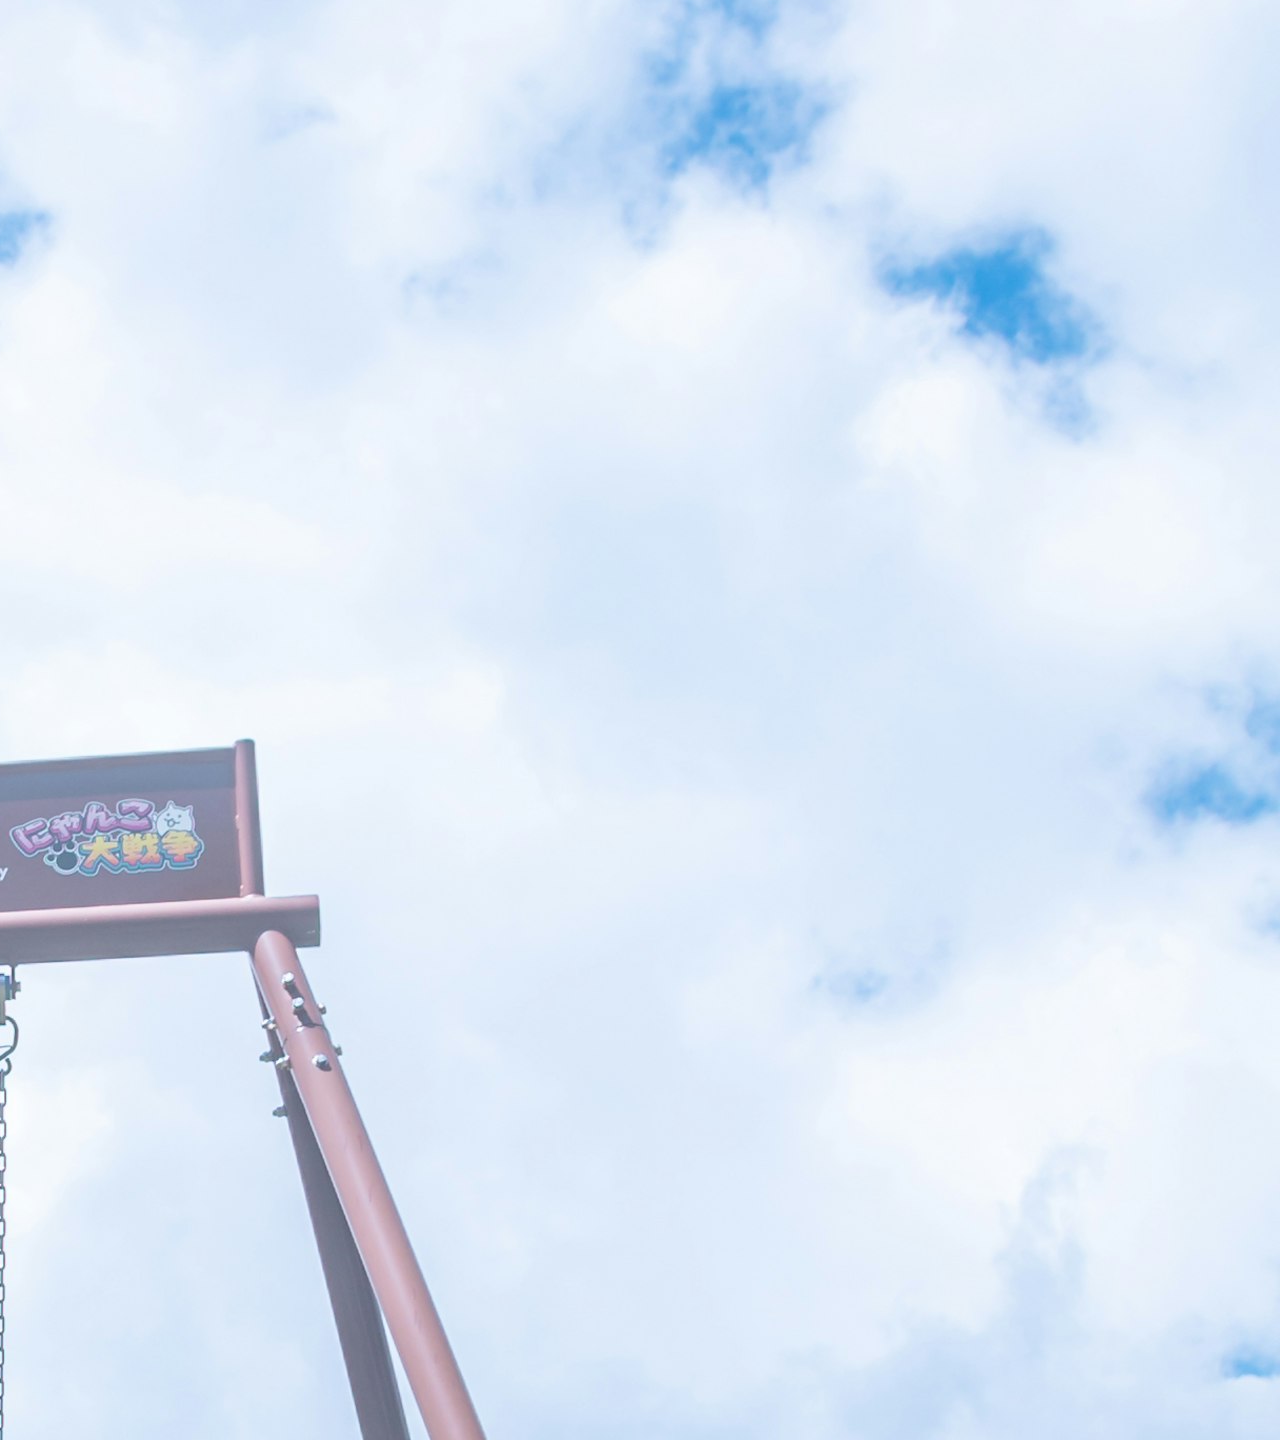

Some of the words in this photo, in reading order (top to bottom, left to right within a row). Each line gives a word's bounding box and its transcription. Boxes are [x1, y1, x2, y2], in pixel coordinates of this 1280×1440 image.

[11, 799, 154, 855] にゃんこ
[81, 830, 201, 870] 大戦争
